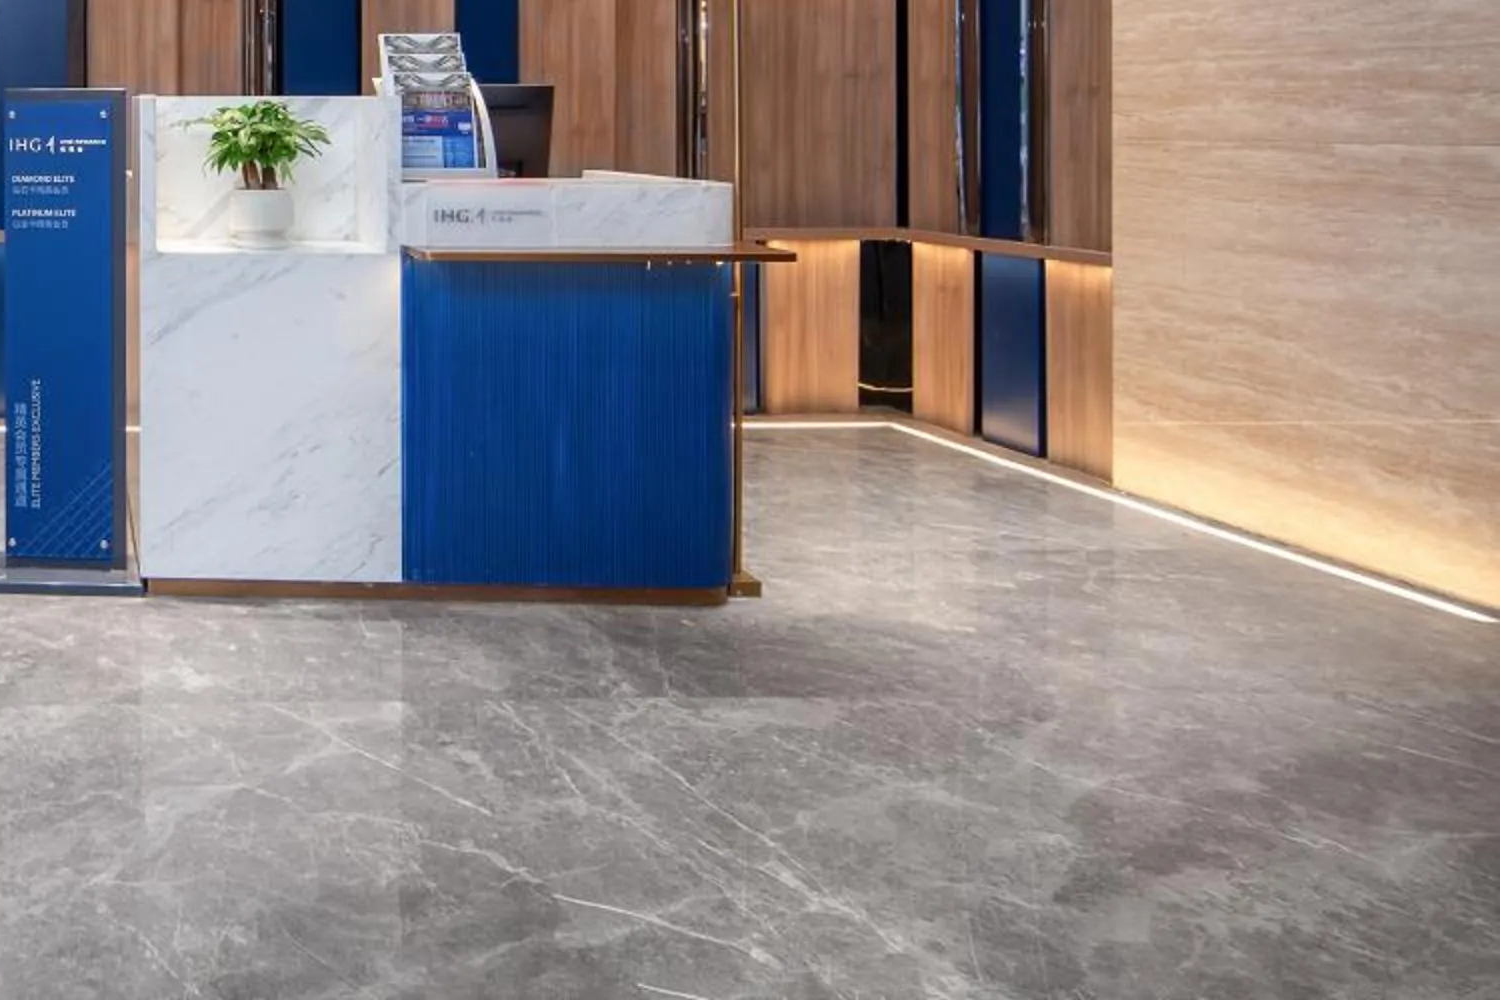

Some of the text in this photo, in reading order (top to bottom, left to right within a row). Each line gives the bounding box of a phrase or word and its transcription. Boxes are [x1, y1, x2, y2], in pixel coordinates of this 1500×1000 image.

[9, 137, 41, 152] IHG
[12, 175, 75, 183] DIAMOND ELITE
[12, 209, 76, 217] PLATINUM ELITE
